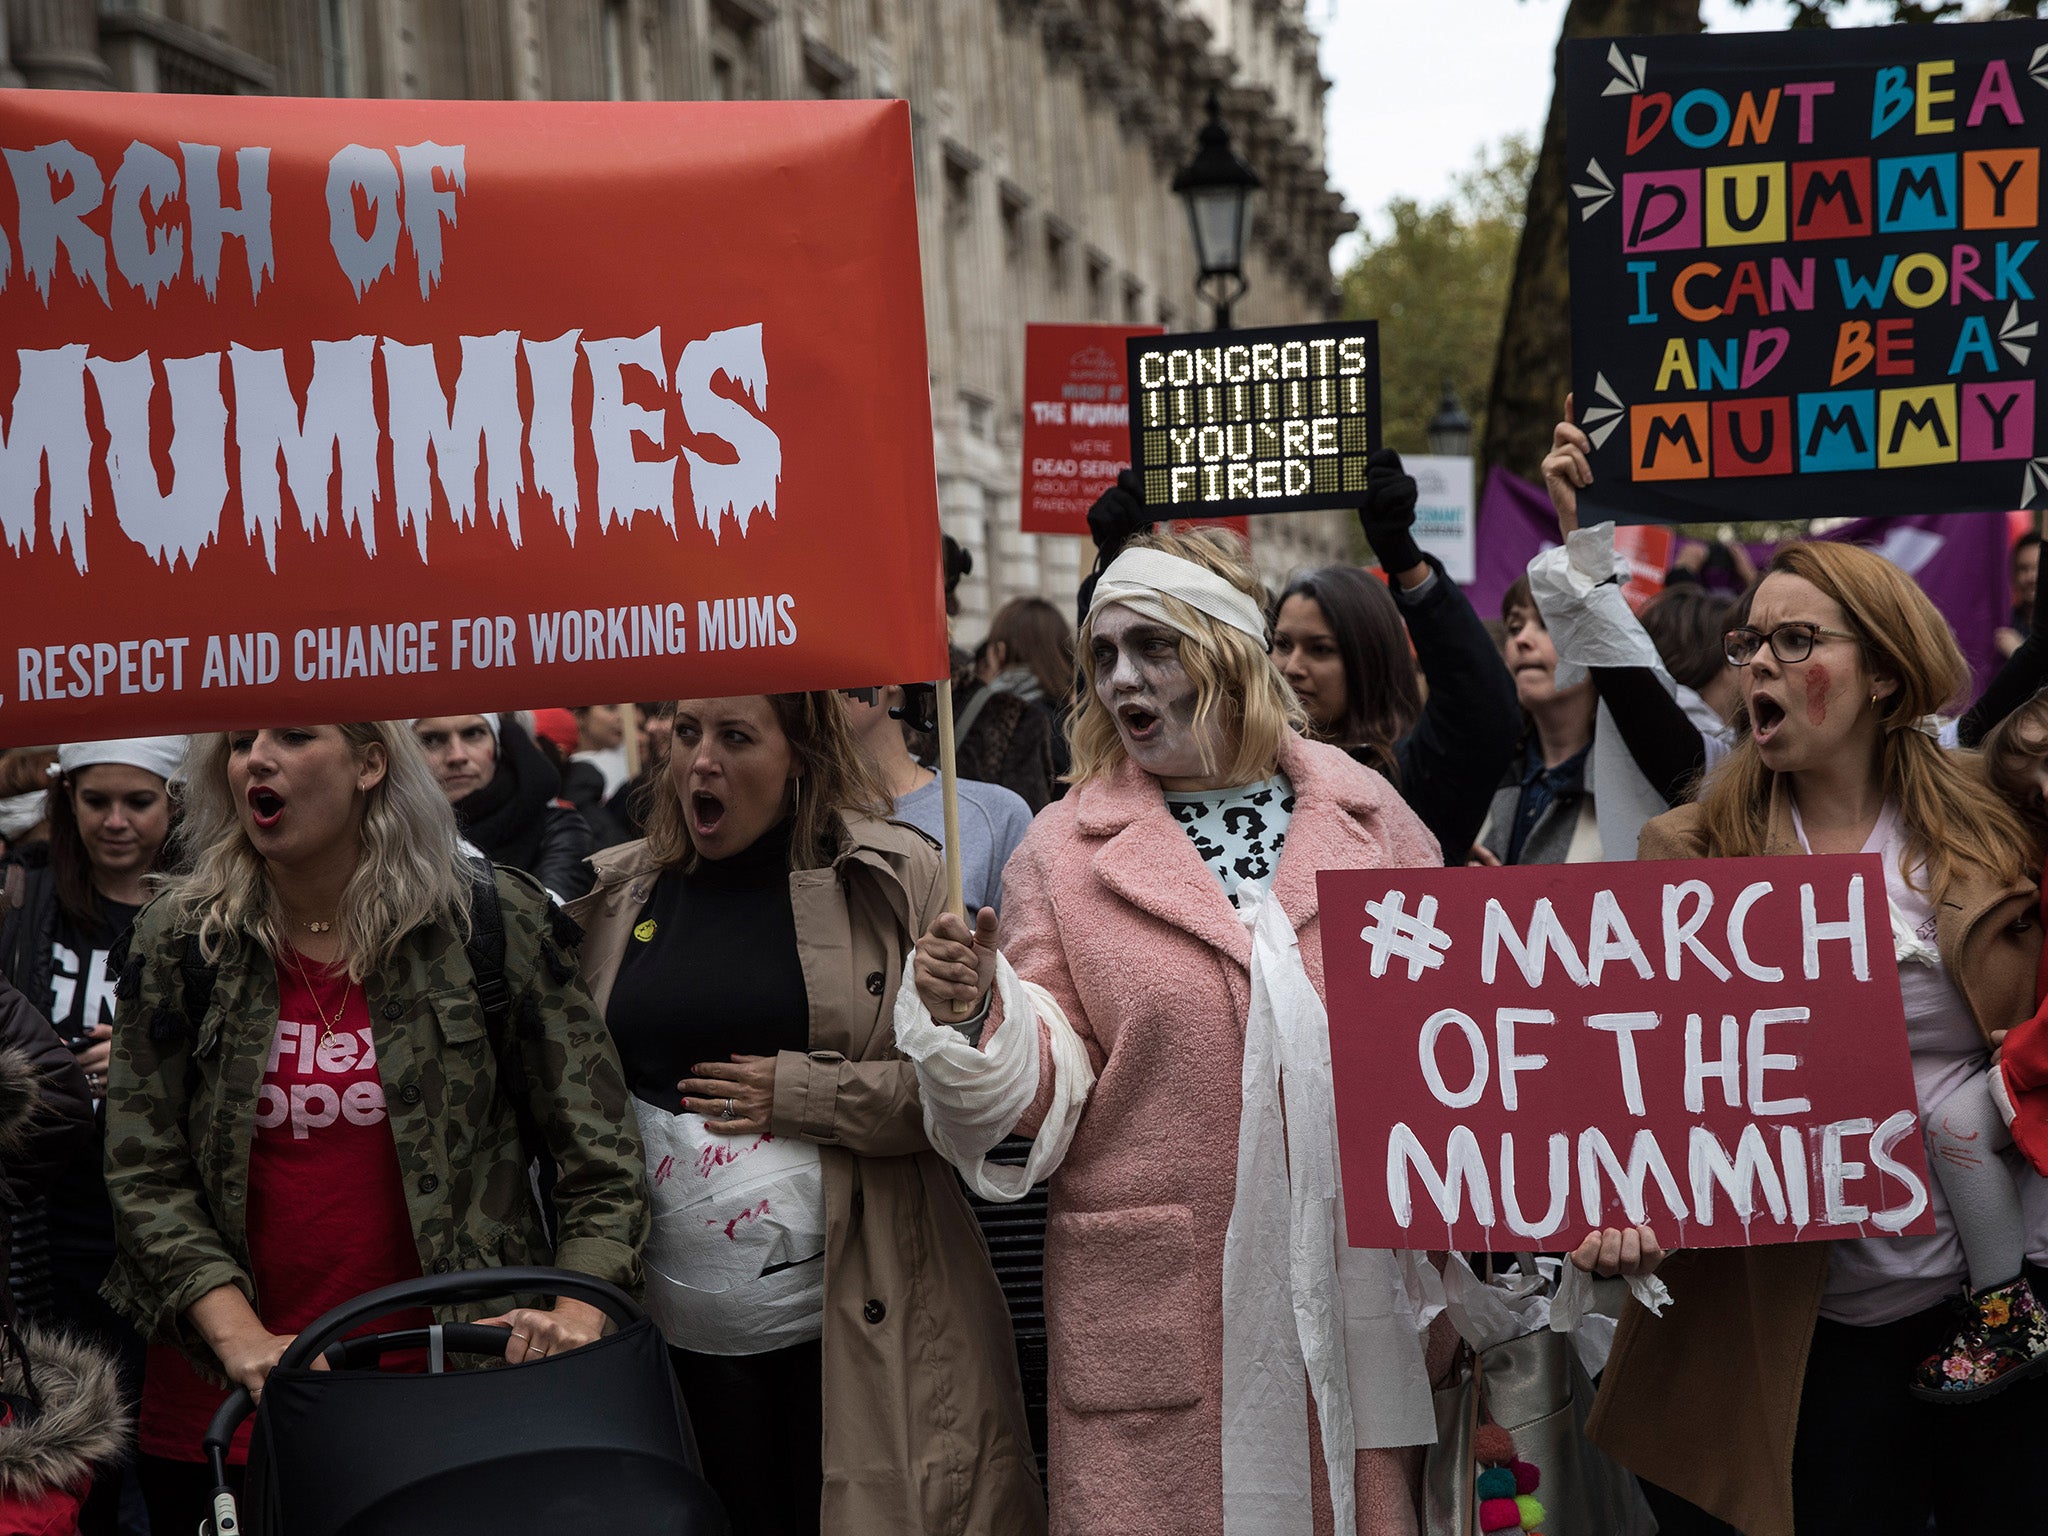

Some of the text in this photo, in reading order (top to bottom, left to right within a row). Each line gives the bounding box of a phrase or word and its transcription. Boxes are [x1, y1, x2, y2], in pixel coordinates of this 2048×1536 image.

[1625, 59, 2025, 156] DONT BE A
[0, 139, 467, 312] RCH OF
[1627, 160, 2025, 247] DUMMY
[1627, 240, 2040, 324] I CAN WORK
[1140, 337, 1366, 389] CONGRATS
[1654, 316, 1999, 391] AND BE A
[1032, 458, 1078, 477] DEAD
[1641, 393, 2021, 470] MUMMY
[1172, 460, 1311, 504] FIRED
[18, 593, 798, 701] RESPECT AND CHANGE FOR WORKING MUMS
[1419, 1006, 1812, 1117] OF THE
[1387, 1110, 1928, 1240] MUMMIES
